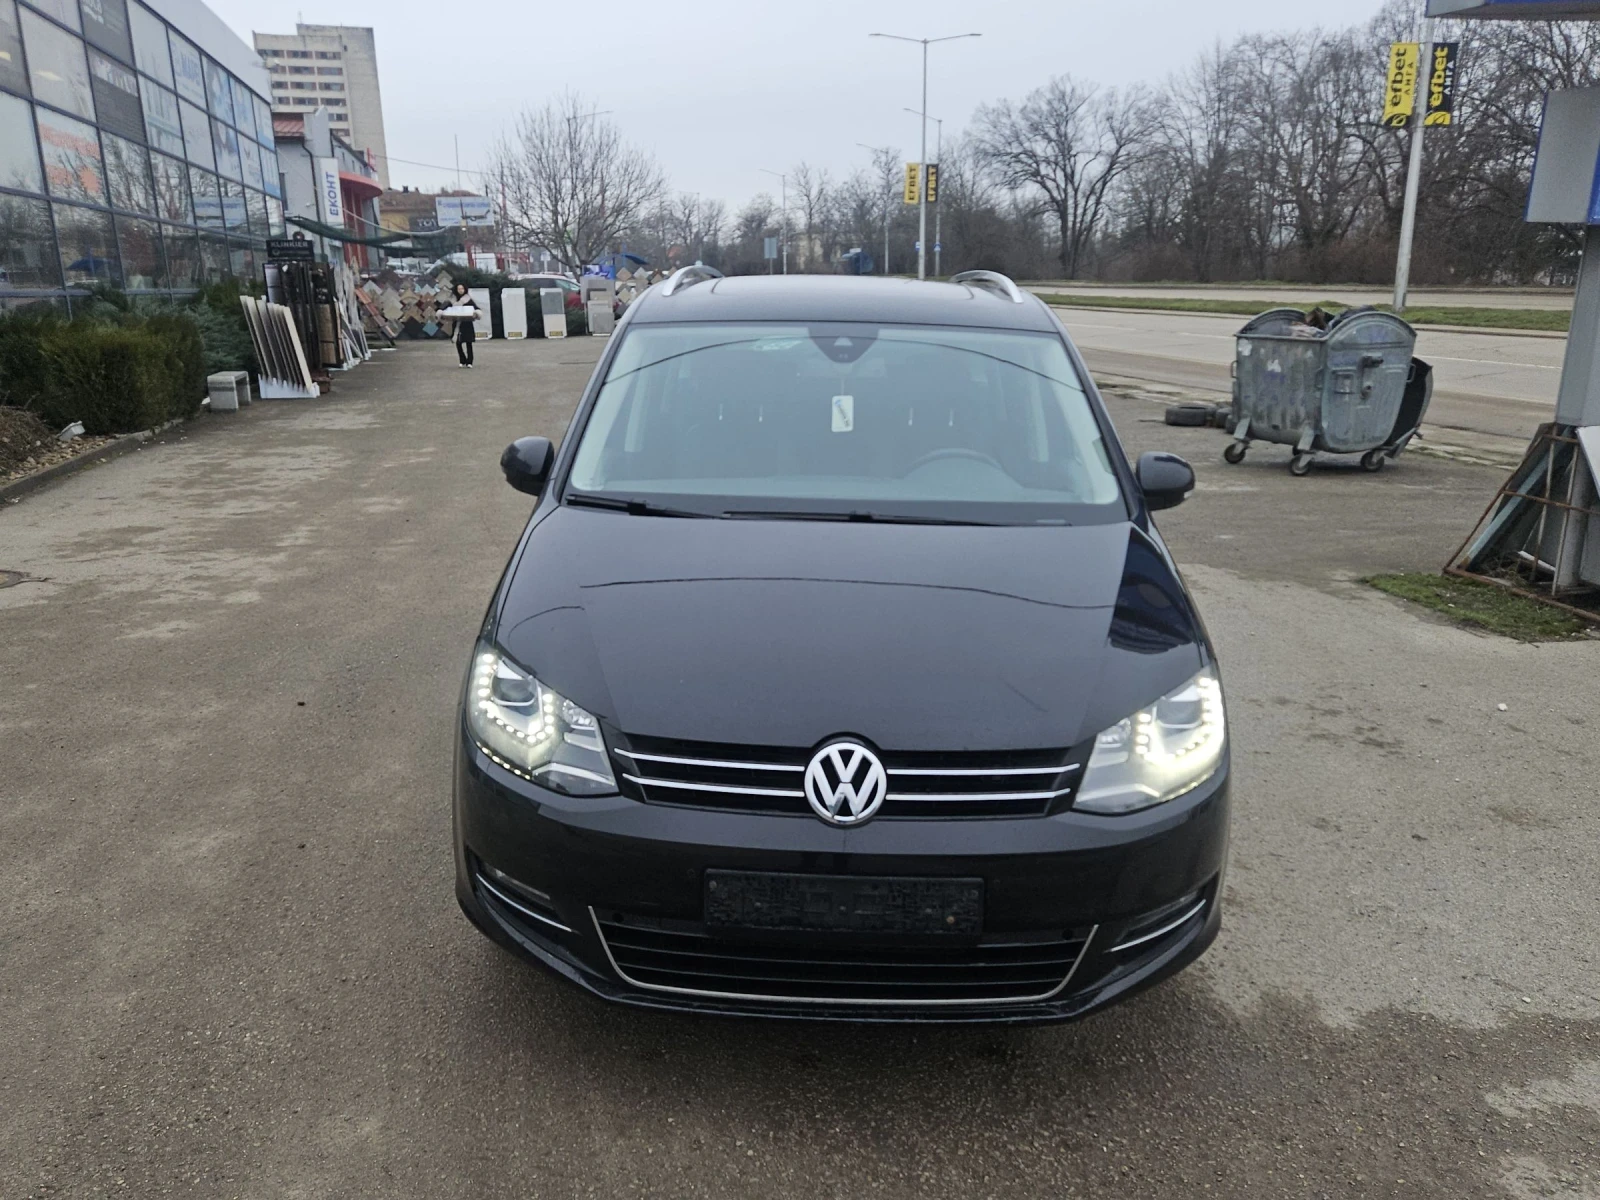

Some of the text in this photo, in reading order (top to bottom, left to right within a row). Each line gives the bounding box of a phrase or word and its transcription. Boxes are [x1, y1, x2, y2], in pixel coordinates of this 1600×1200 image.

[1391, 47, 1407, 106] efbet
[1429, 46, 1448, 107] efbet
[325, 171, 339, 216] ЕКОНТ
